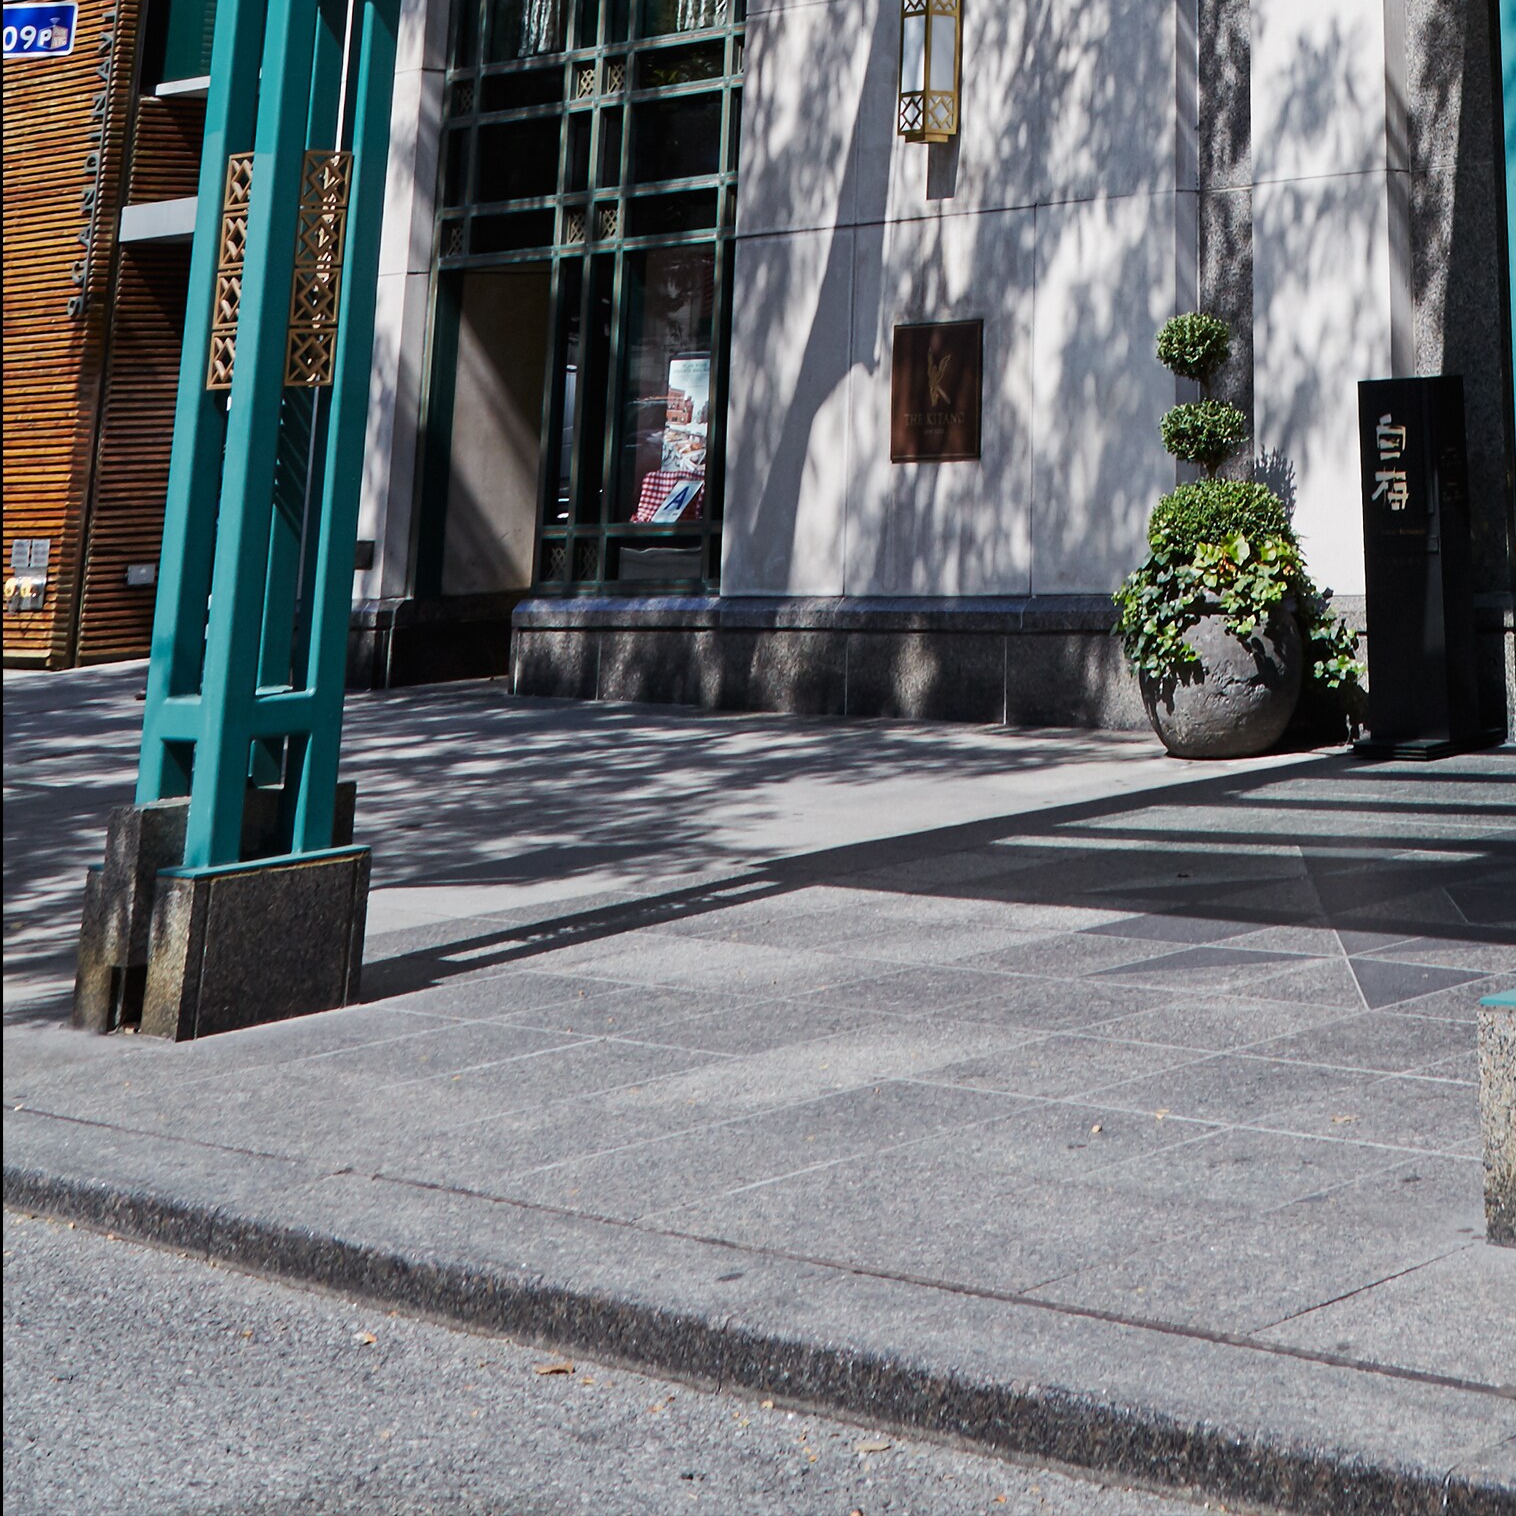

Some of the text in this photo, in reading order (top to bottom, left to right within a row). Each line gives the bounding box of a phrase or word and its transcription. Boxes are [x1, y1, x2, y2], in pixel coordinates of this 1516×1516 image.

[904, 411, 966, 427] THE KITANO
[663, 485, 690, 511] A
